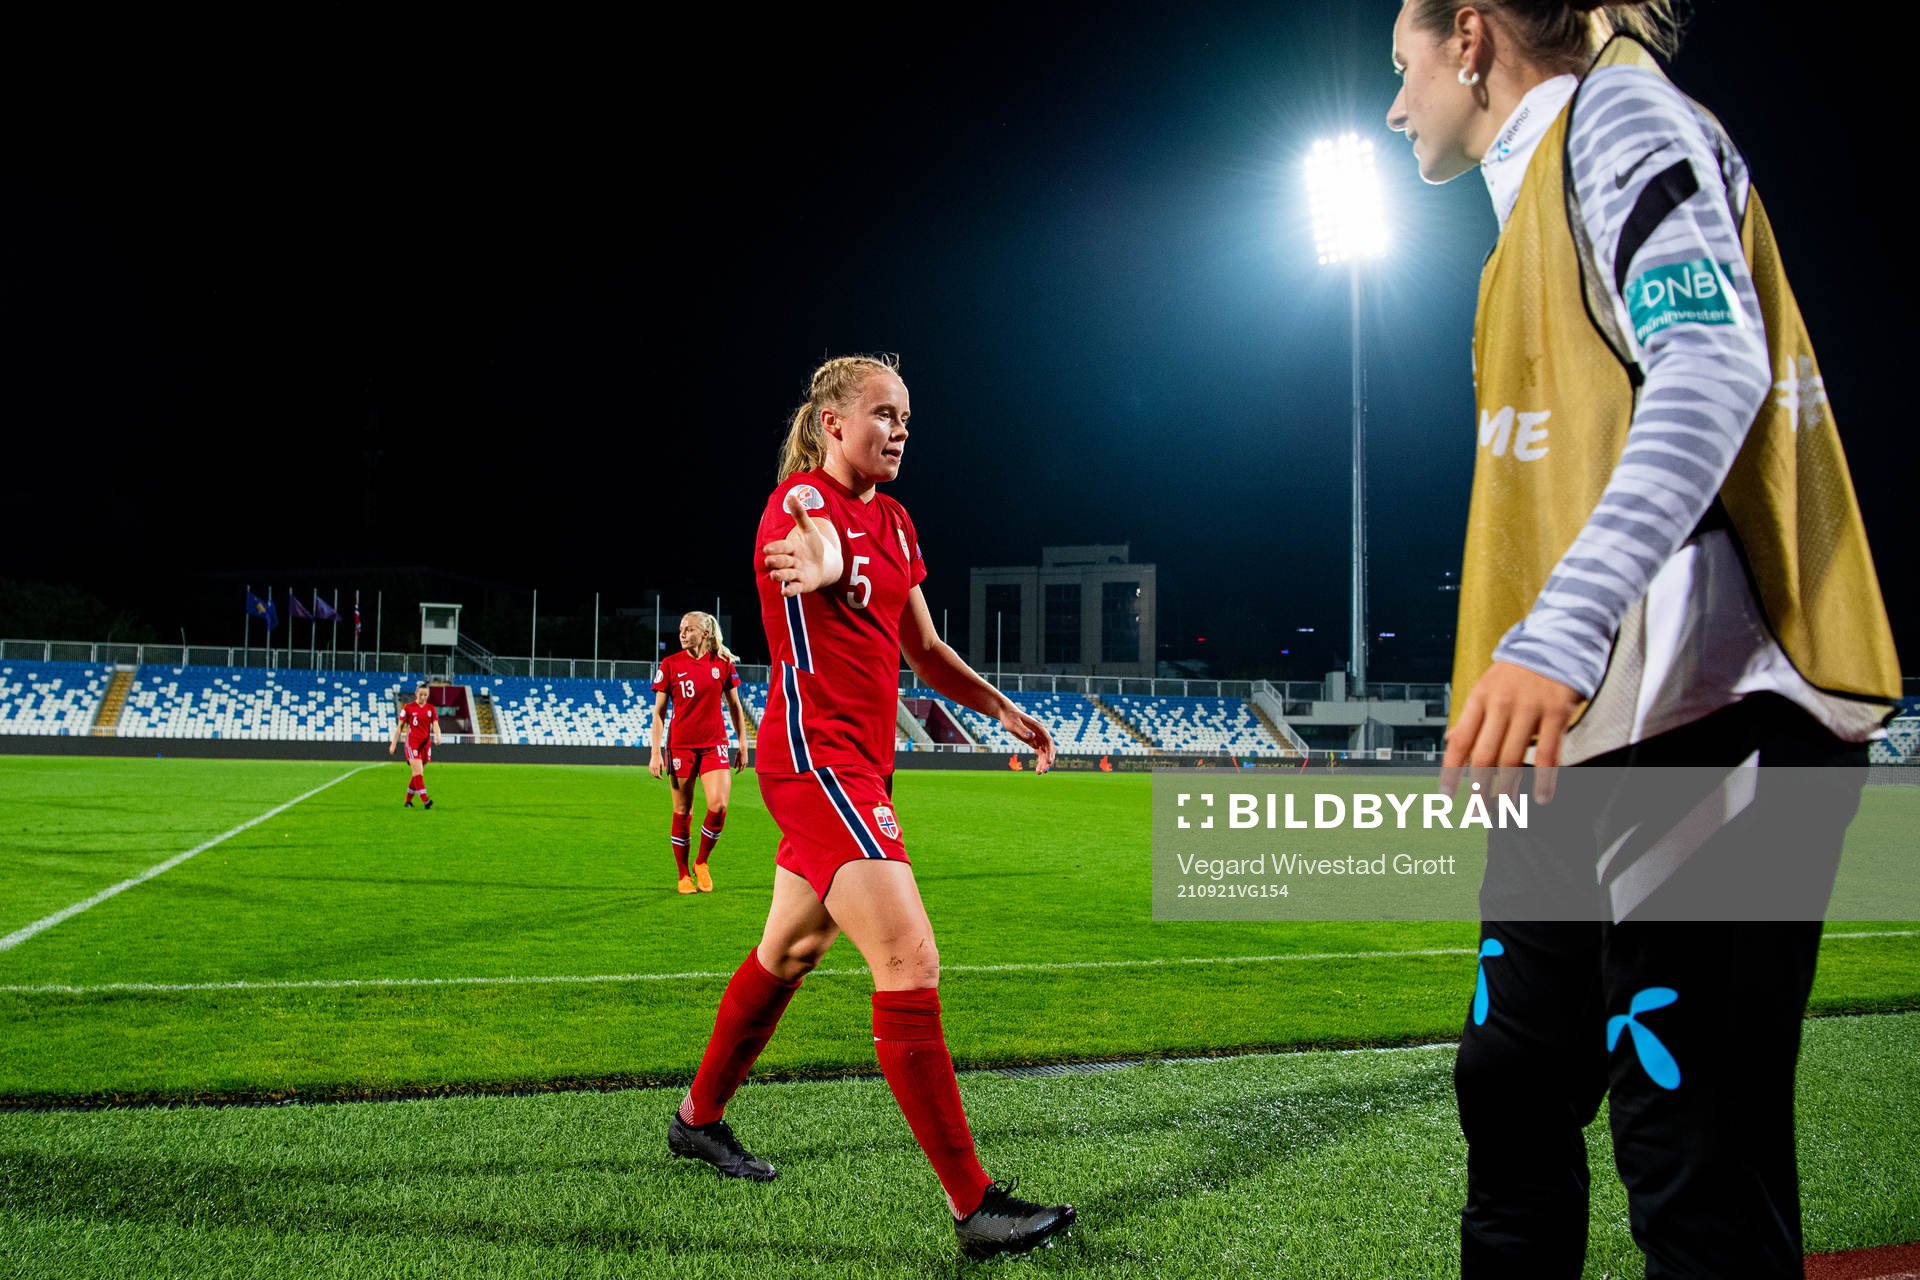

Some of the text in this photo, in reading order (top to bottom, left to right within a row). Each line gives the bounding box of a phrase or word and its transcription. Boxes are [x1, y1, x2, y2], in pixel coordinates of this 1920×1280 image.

[1642, 265, 1719, 309] DNB
[846, 555, 873, 610] 5
[679, 679, 696, 699] 13
[412, 716, 419, 727] 6
